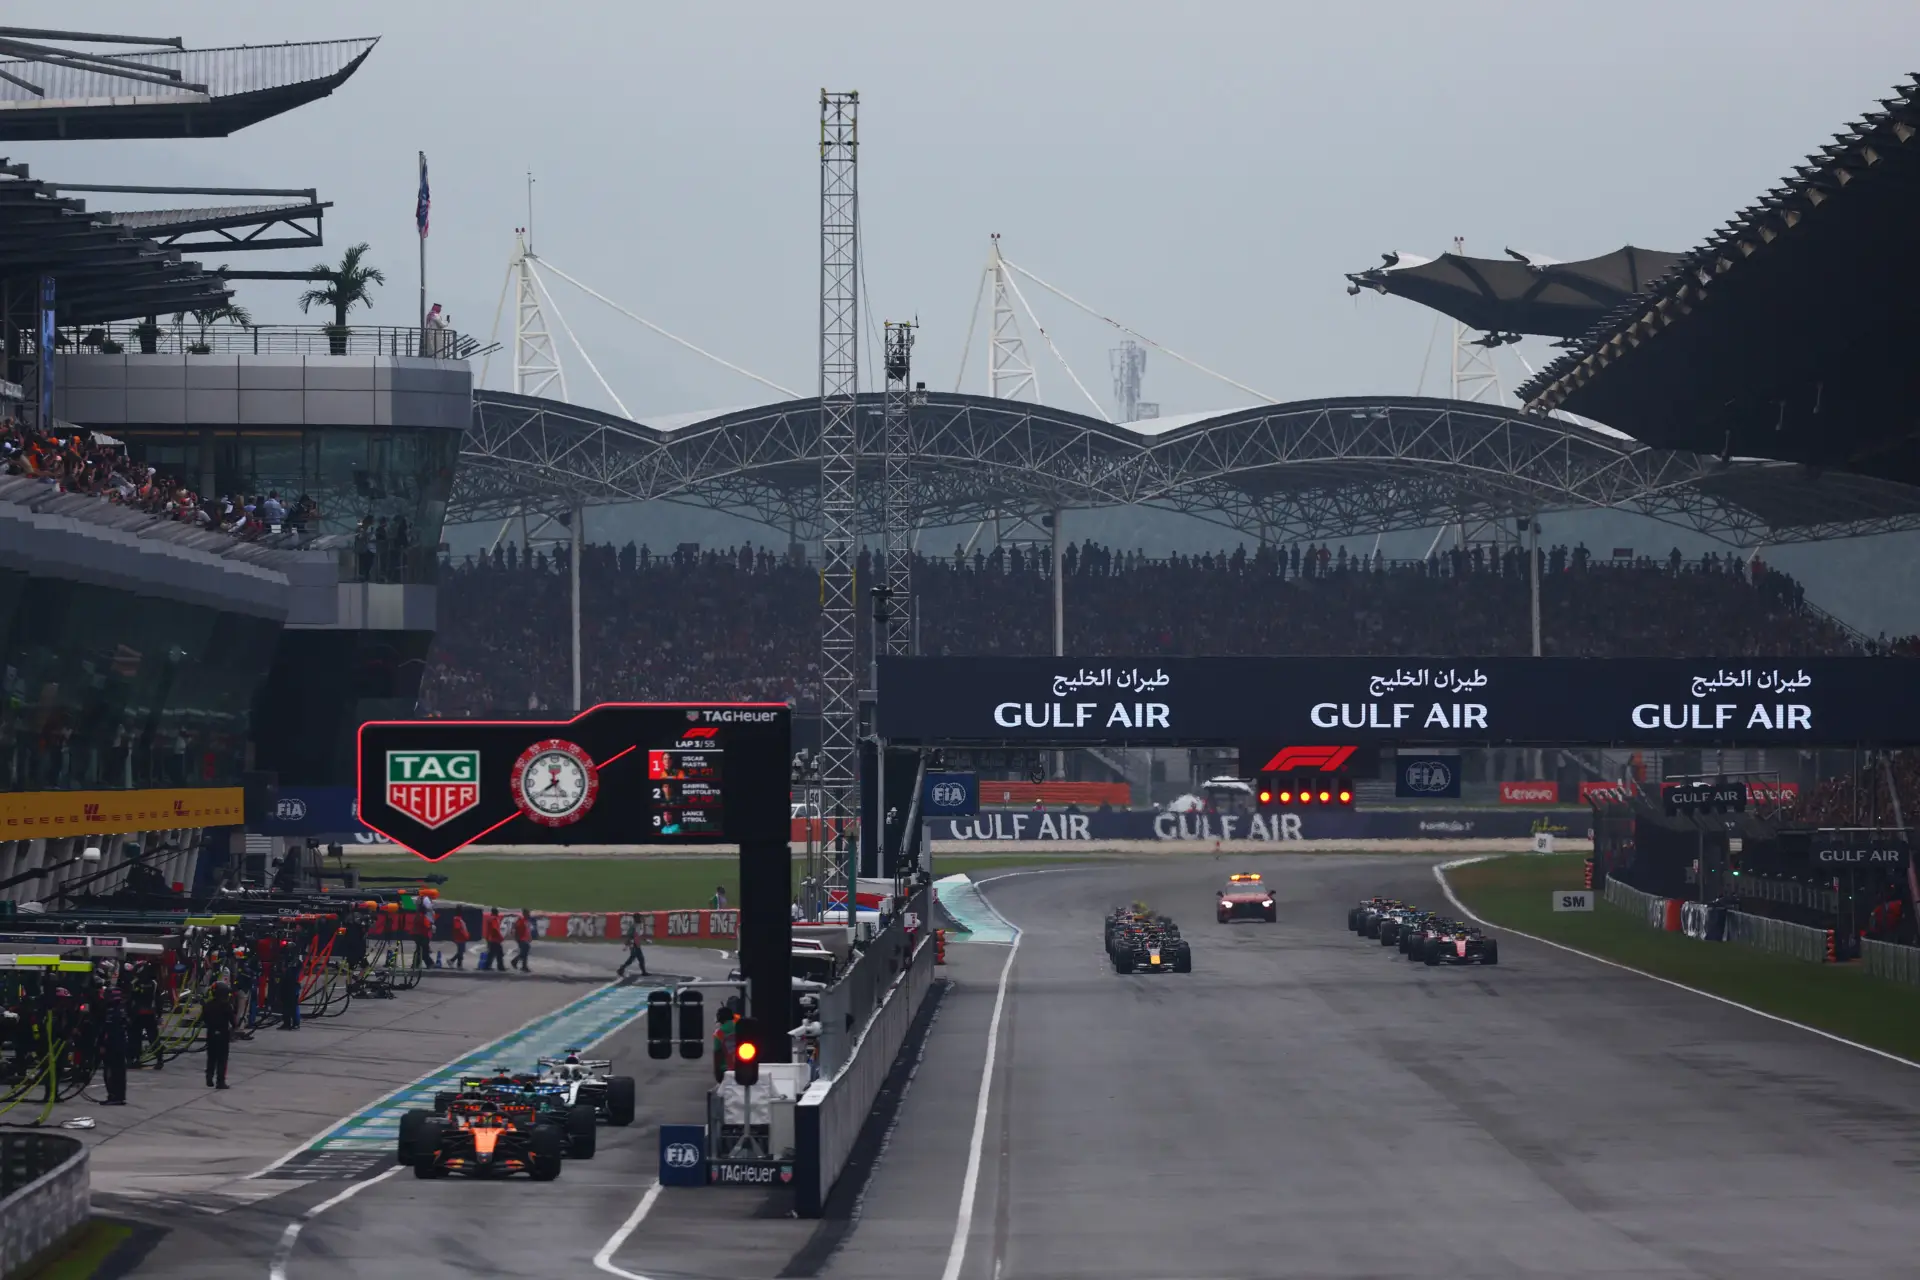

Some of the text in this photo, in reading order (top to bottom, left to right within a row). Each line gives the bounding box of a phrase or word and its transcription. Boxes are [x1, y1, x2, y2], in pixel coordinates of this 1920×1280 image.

[1053, 669, 1170, 697] طيران الخليج
[1370, 669, 1488, 697] طيران الخليج
[1692, 669, 1812, 698] طيران الخليج
[993, 702, 1171, 729] GULF AIR
[1310, 702, 1488, 729] GULF AIR
[1632, 703, 1812, 730] GULF AIR
[396, 756, 472, 779] TAG
[652, 761, 661, 771] 1
[391, 786, 475, 821] HEUER
[652, 788, 661, 799] 2
[1503, 786, 1553, 800] Lenovo
[1671, 791, 1738, 804] GULF AIR
[652, 815, 661, 826] 3
[950, 813, 1092, 840] GULF AIR
[1154, 813, 1303, 840] GULF AIR
[1819, 849, 1900, 861] GULF AIR
[1562, 895, 1585, 908] SM
[719, 1165, 774, 1182] TAGHeuer
